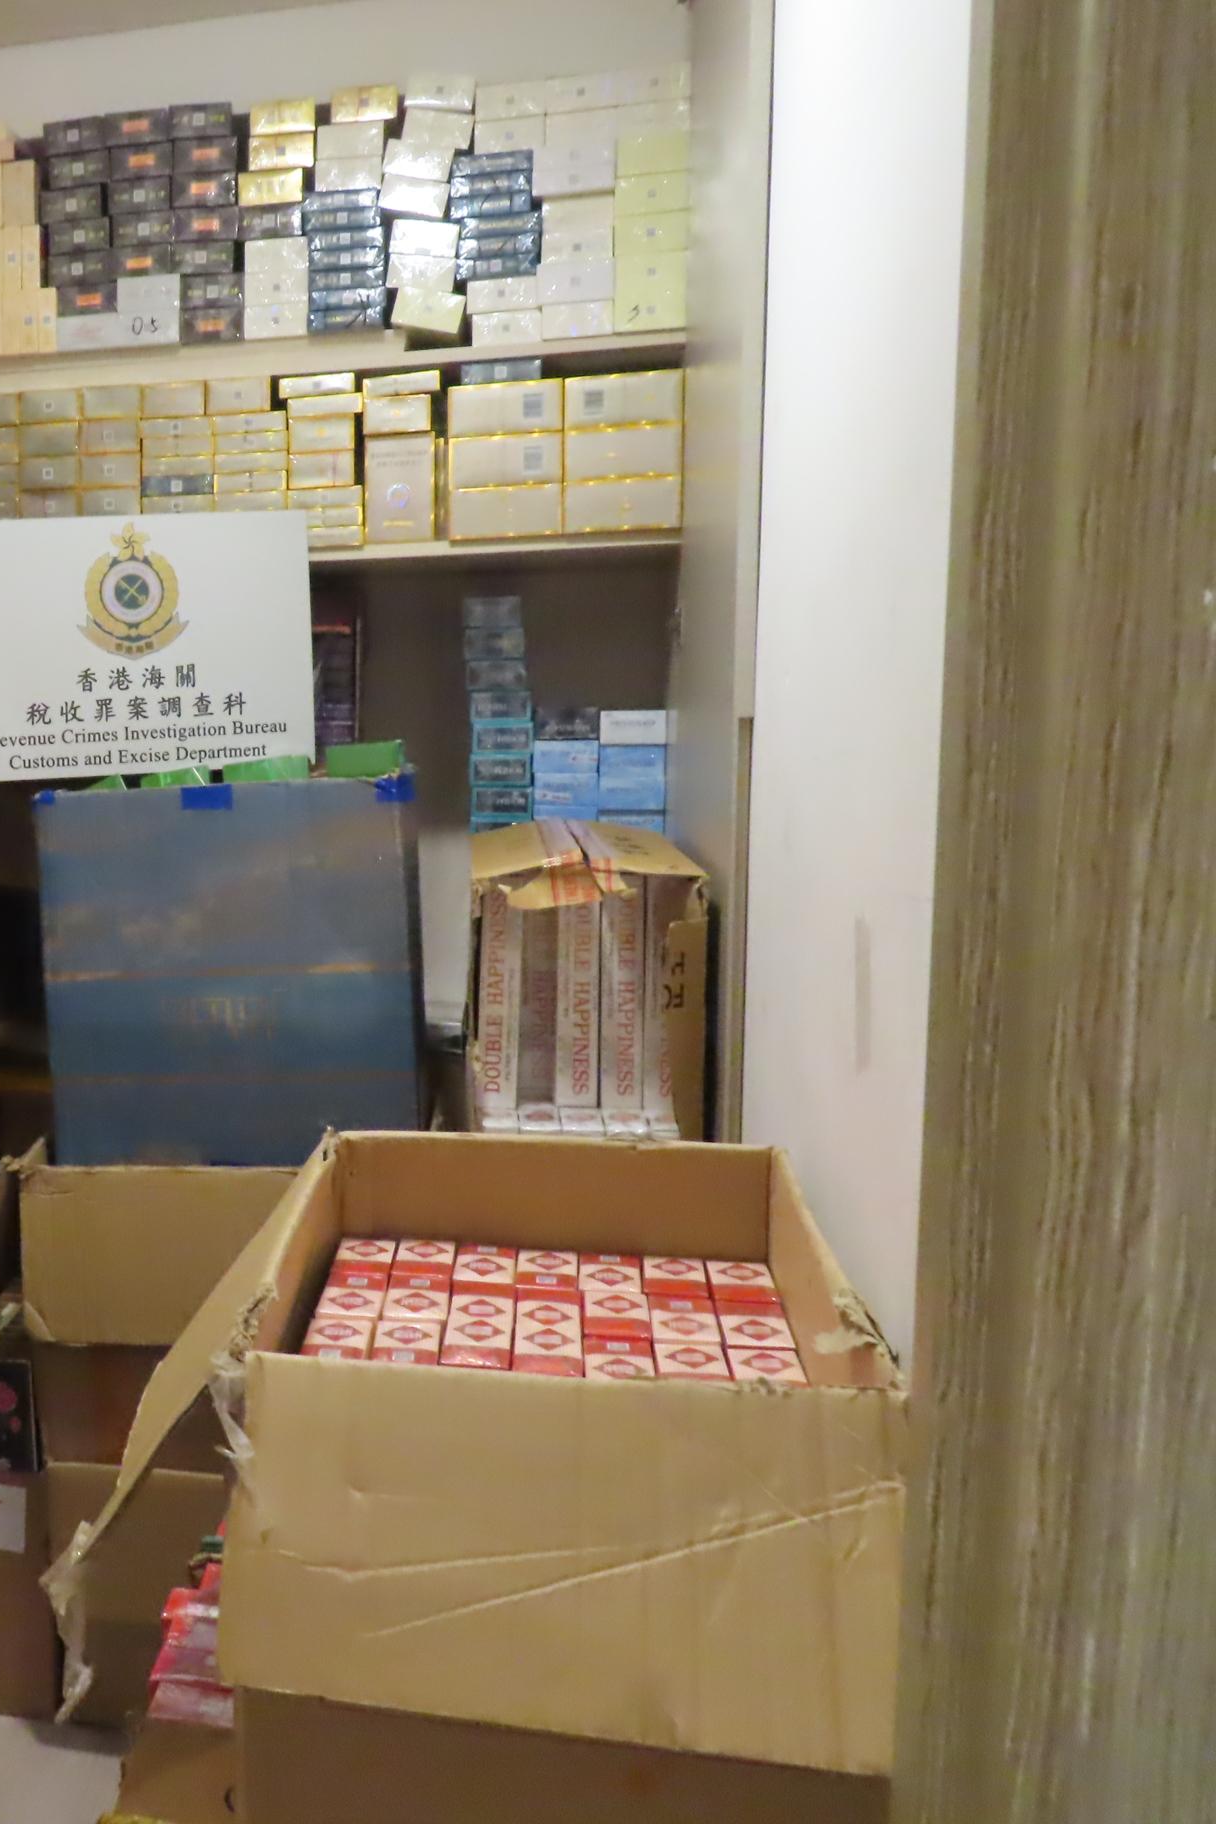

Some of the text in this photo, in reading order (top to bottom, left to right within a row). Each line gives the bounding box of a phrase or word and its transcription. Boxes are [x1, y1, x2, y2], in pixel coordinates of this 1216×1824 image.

[76, 663, 196, 692] 香港海關
[9, 744, 267, 770] Customs and Excise Department
[61, 729, 119, 744] Crimes
[124, 722, 227, 742] Investigation
[232, 721, 287, 735] Bureau
[573, 903, 592, 973] OUBLE
[484, 889, 507, 1093] DOUBLE HAPPINESS
[572, 981, 592, 1096] HAPPINESS
[616, 981, 636, 1096] HAPPINESS
